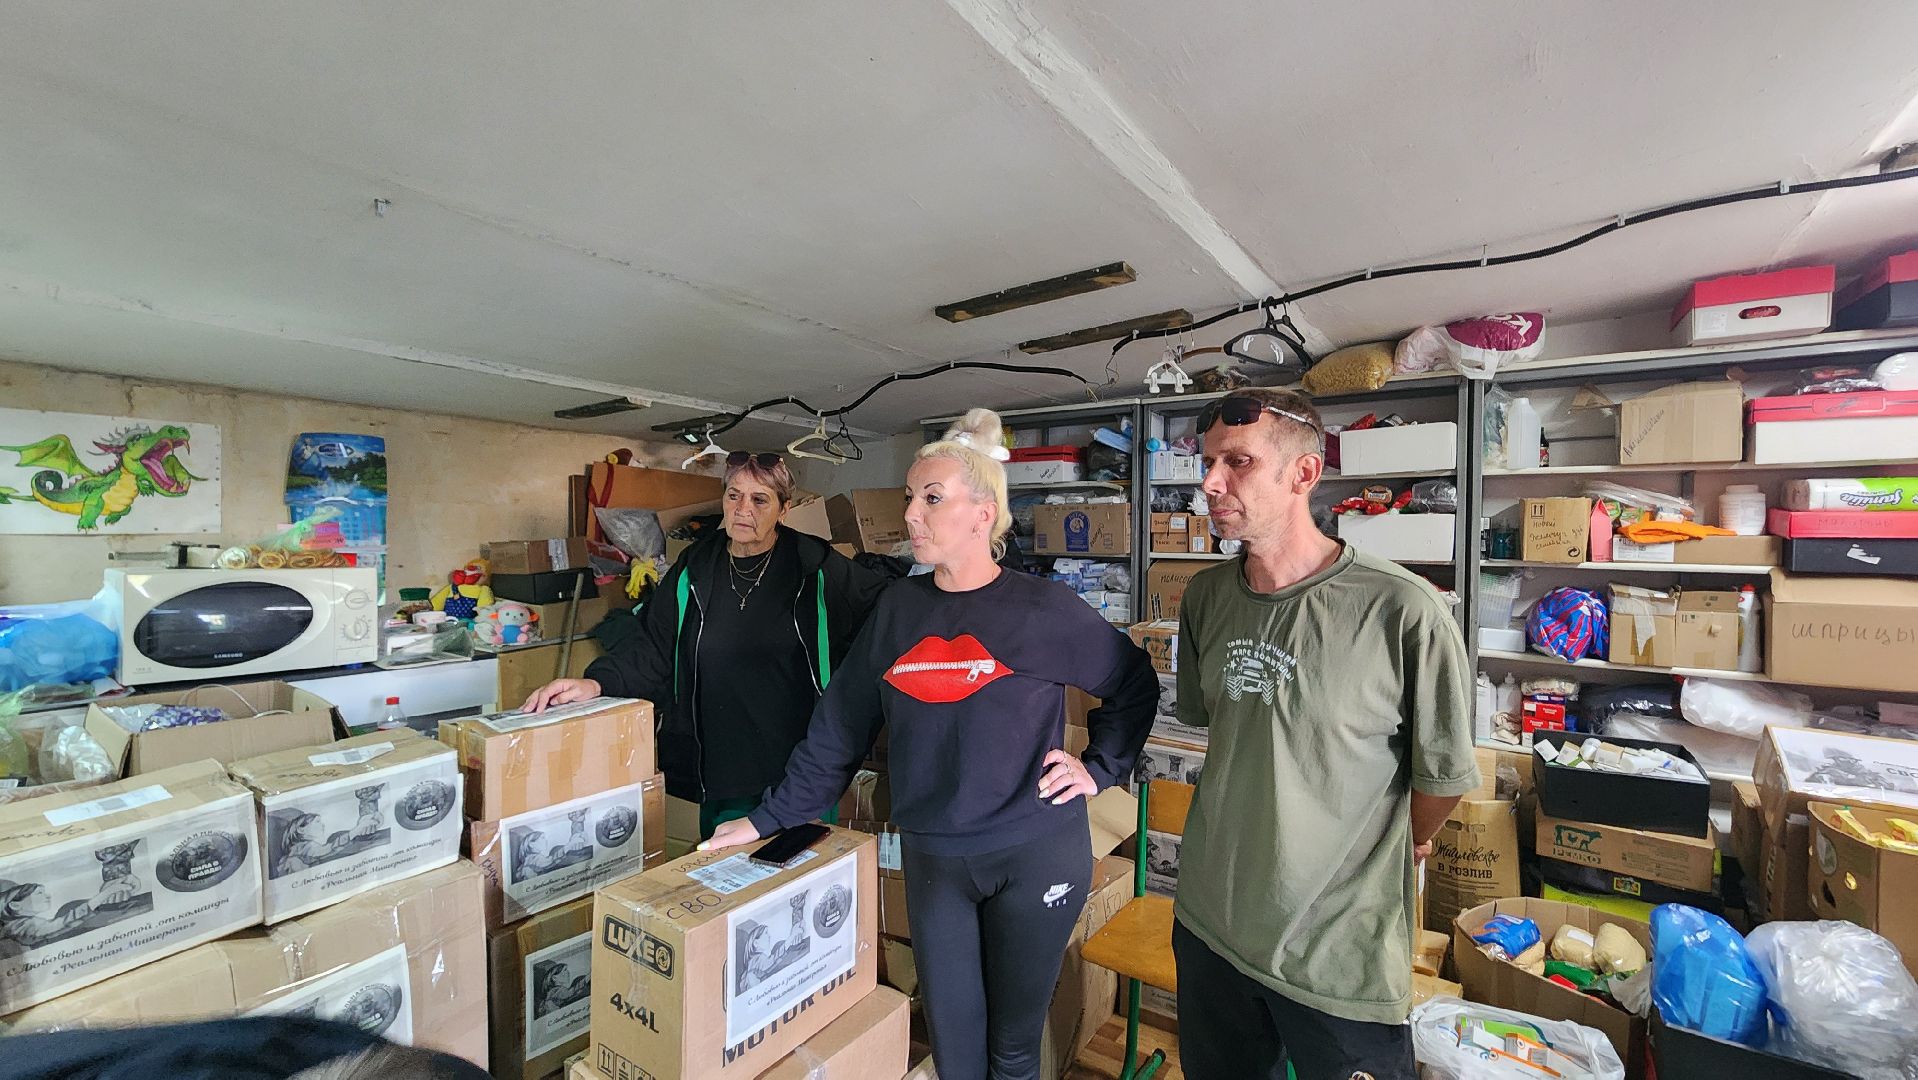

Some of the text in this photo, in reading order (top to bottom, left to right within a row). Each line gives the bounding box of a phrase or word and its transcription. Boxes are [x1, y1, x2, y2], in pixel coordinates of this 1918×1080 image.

[1437, 862, 1445, 871] В
[1049, 882, 1069, 895] NIKE
[666, 894, 722, 919] СВО
[19, 947, 83, 973] Любовью
[87, 943, 95, 952] и
[97, 922, 152, 951] заботой
[178, 897, 229, 920] команды
